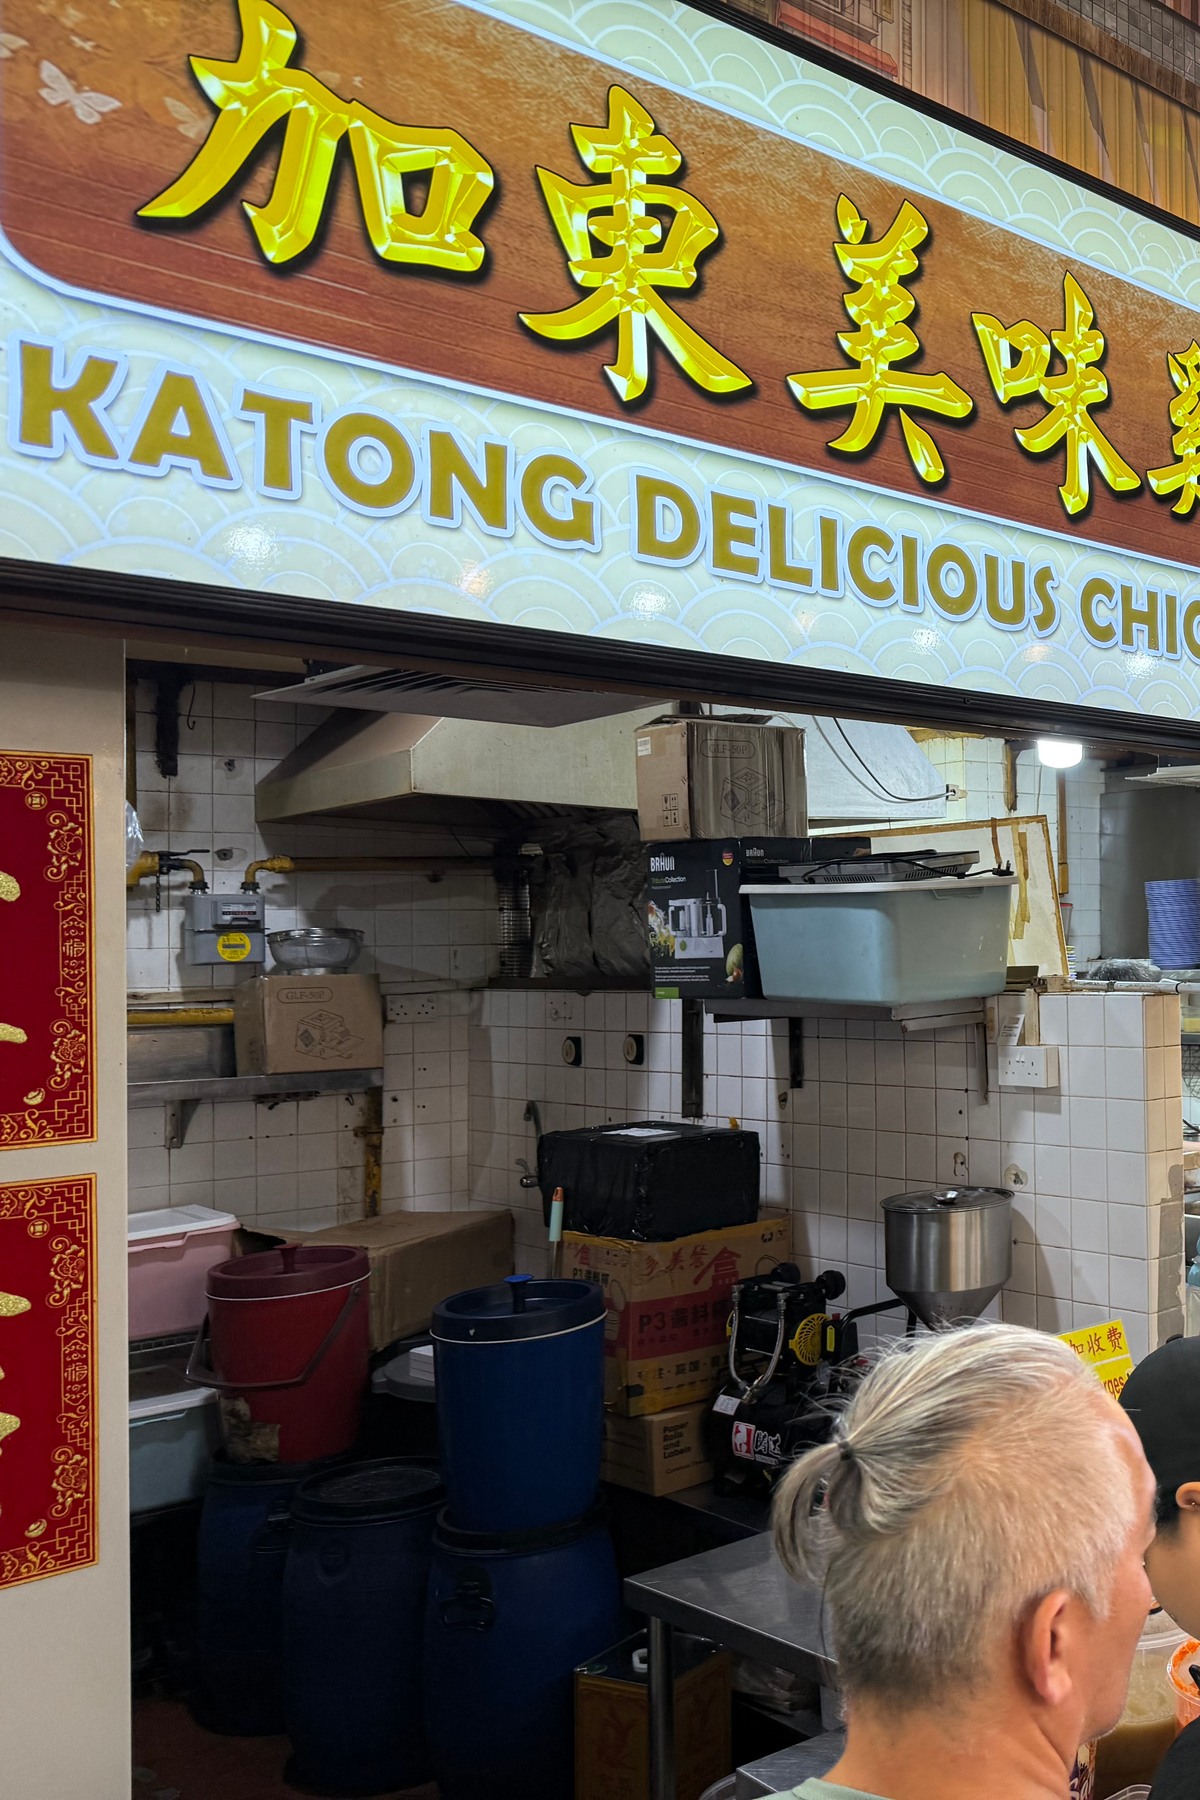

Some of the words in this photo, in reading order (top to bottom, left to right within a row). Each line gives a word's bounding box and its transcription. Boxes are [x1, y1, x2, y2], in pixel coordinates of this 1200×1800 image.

[19, 340, 595, 546] KATONG
[634, 475, 1057, 632] DELICIOUS
[745, 847, 765, 857] BRAUN
[650, 853, 675, 872] BRAUN
[1102, 1375, 1125, 1400] rges
[663, 1421, 689, 1434] Paper
[663, 1431, 683, 1443] Rolls
[663, 1440, 680, 1451] and
[663, 1446, 691, 1459] Labels
